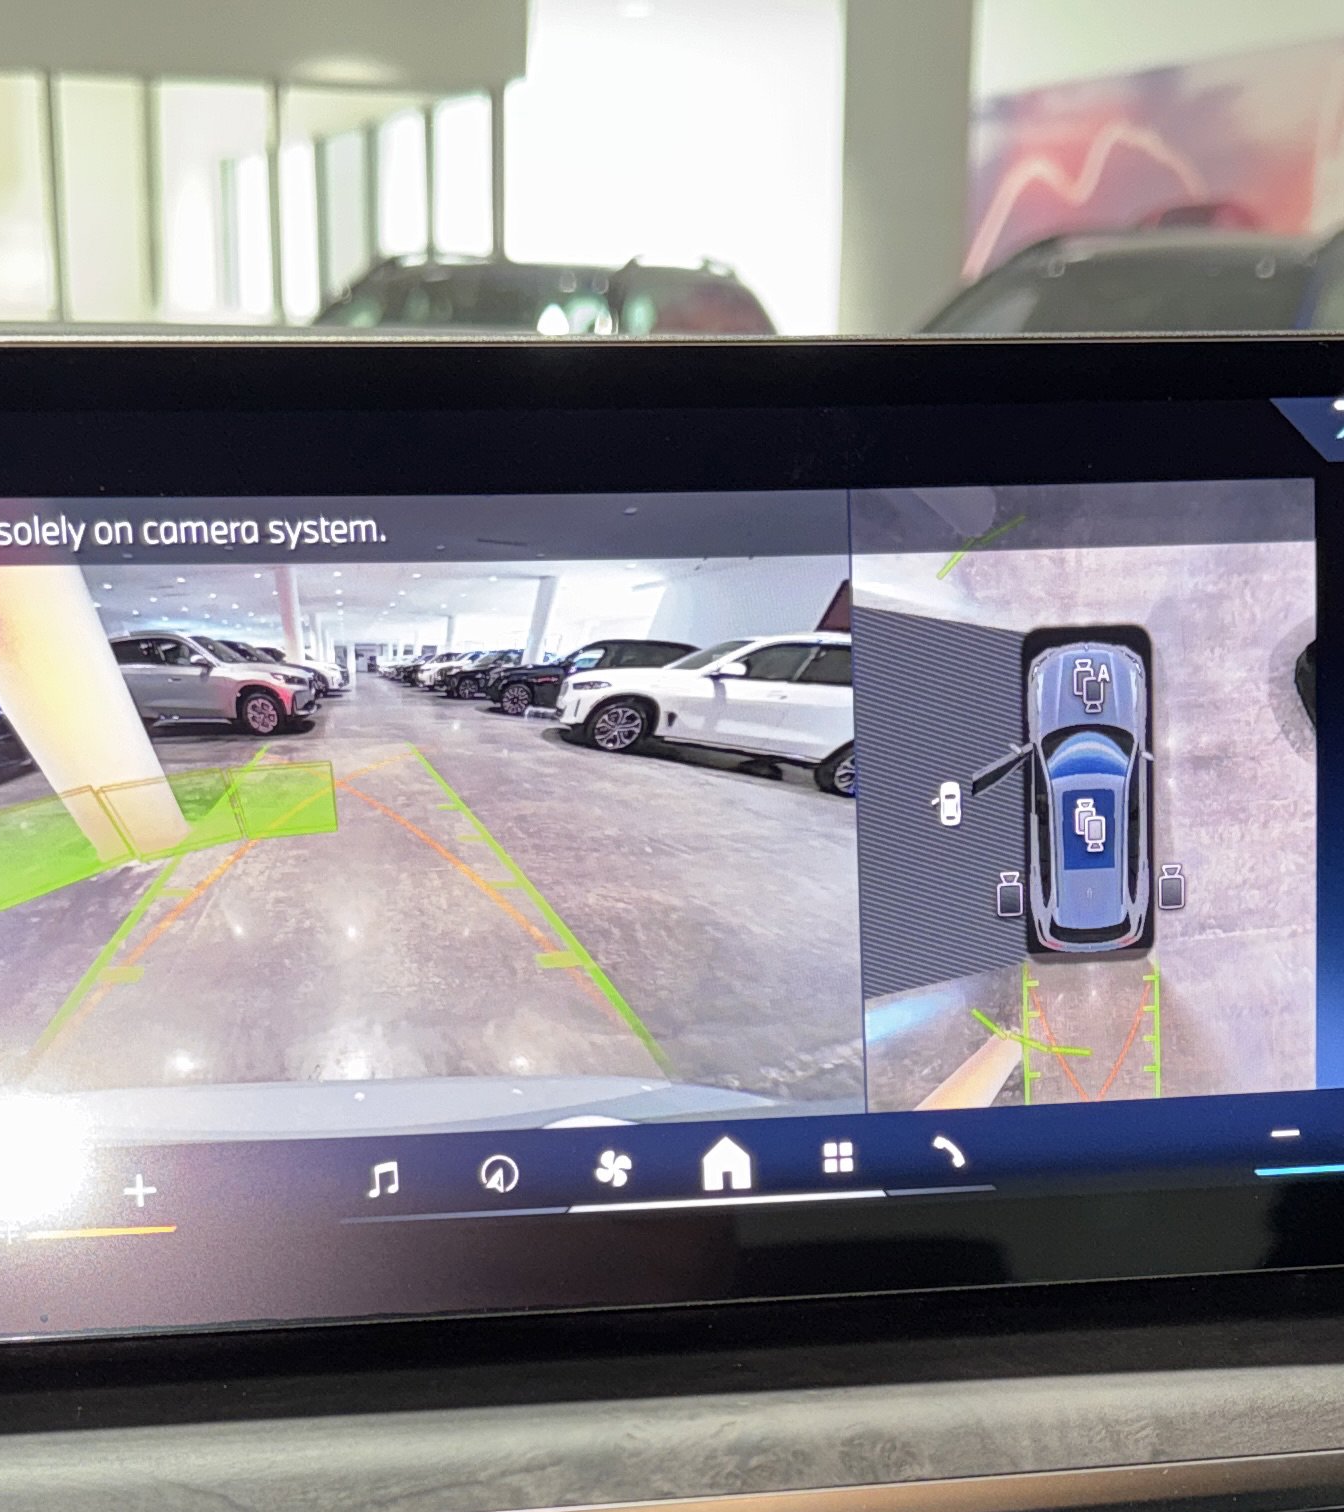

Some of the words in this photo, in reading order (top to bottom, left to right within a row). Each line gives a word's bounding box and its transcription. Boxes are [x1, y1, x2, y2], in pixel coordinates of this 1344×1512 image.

[94, 519, 133, 545] on
[142, 518, 258, 545] camera
[269, 516, 387, 551] system.
